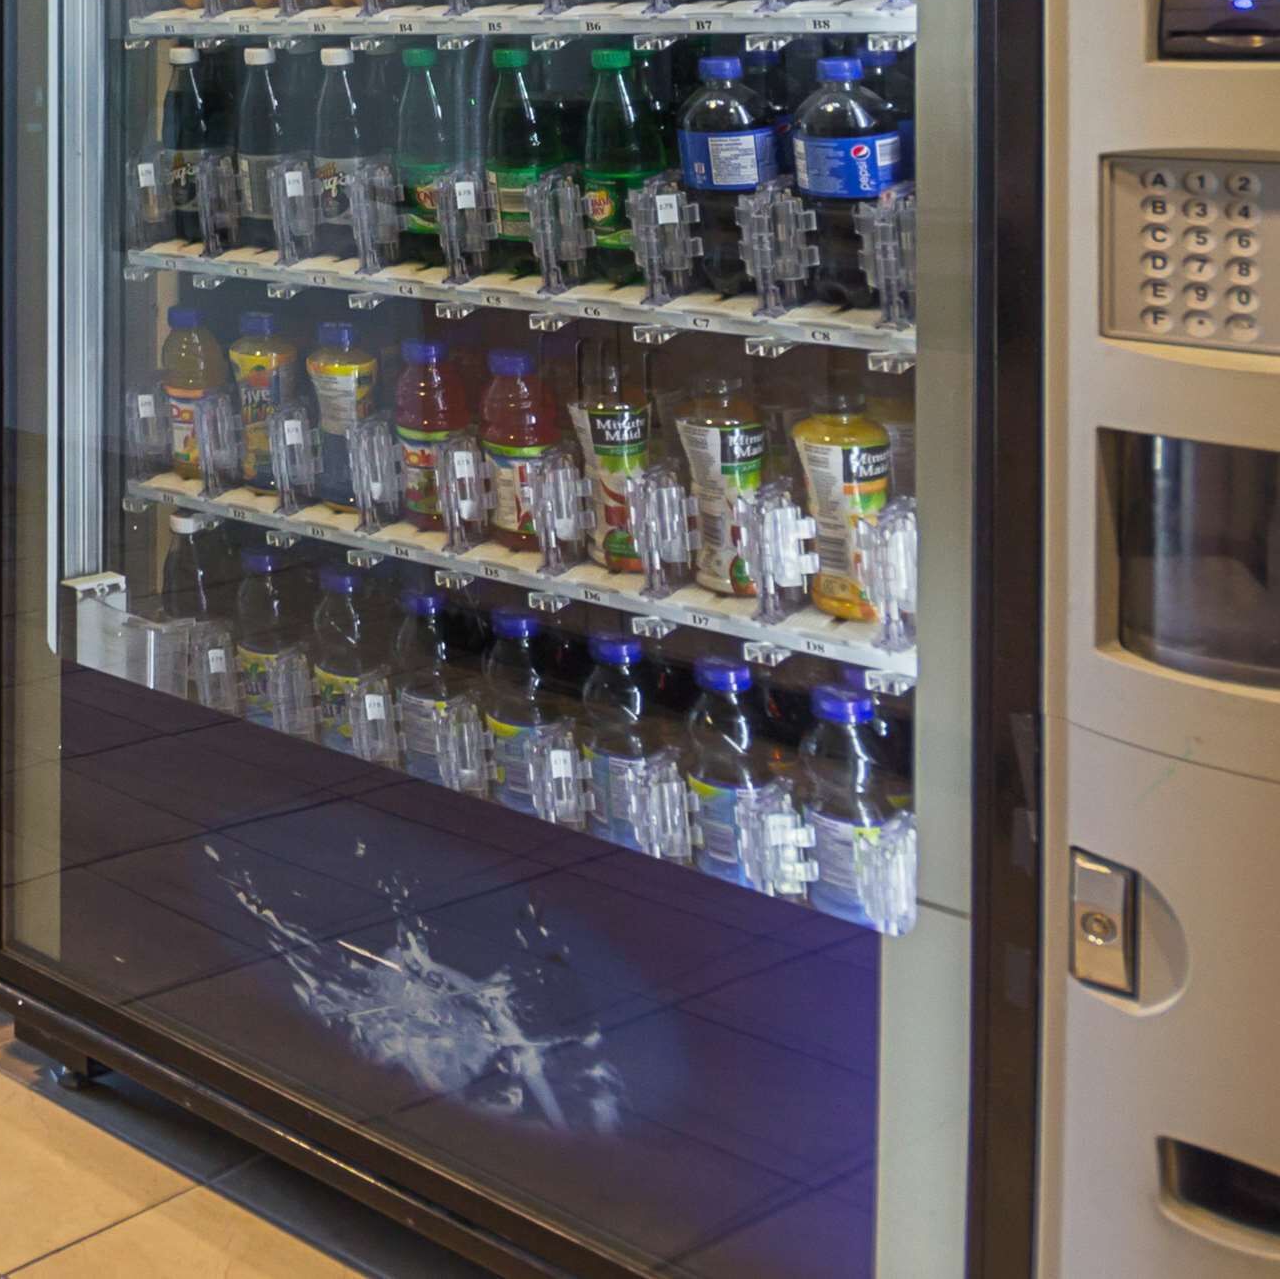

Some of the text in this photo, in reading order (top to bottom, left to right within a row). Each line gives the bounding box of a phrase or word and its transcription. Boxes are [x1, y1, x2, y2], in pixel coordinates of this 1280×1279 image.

[238, 24, 250, 33] B2
[399, 23, 413, 32] B4
[488, 22, 502, 32] B5
[586, 21, 601, 31] B6
[695, 20, 712, 30] B7
[813, 20, 830, 29] B8
[859, 160, 873, 191] pepsi
[1152, 173, 1167, 188] A
[1197, 175, 1206, 188] 1
[1237, 178, 1251, 191] 2
[1152, 200, 1166, 215] B
[1195, 204, 1208, 217] 3
[1237, 206, 1251, 219] 4
[1152, 229, 1168, 243] C
[1195, 233, 1208, 246] 5
[1237, 234, 1251, 249] 6
[1152, 256, 1168, 271] D
[1195, 259, 1208, 273] 7
[1238, 263, 1251, 277] 8
[236, 266, 247, 276] C2
[398, 285, 413, 295] C4
[1152, 284, 1166, 298] E
[1195, 287, 1208, 302] 9
[486, 296, 501, 305] C5
[1237, 290, 1251, 305] 0
[584, 306, 600, 316] C6
[693, 318, 710, 328] C7
[1152, 311, 1166, 325] F
[811, 330, 830, 341] C8
[233, 509, 246, 519] D2
[395, 546, 409, 557] D4
[484, 567, 500, 577] D5
[584, 590, 600, 602] D6
[693, 614, 709, 626] D7
[807, 640, 825, 653] D8
